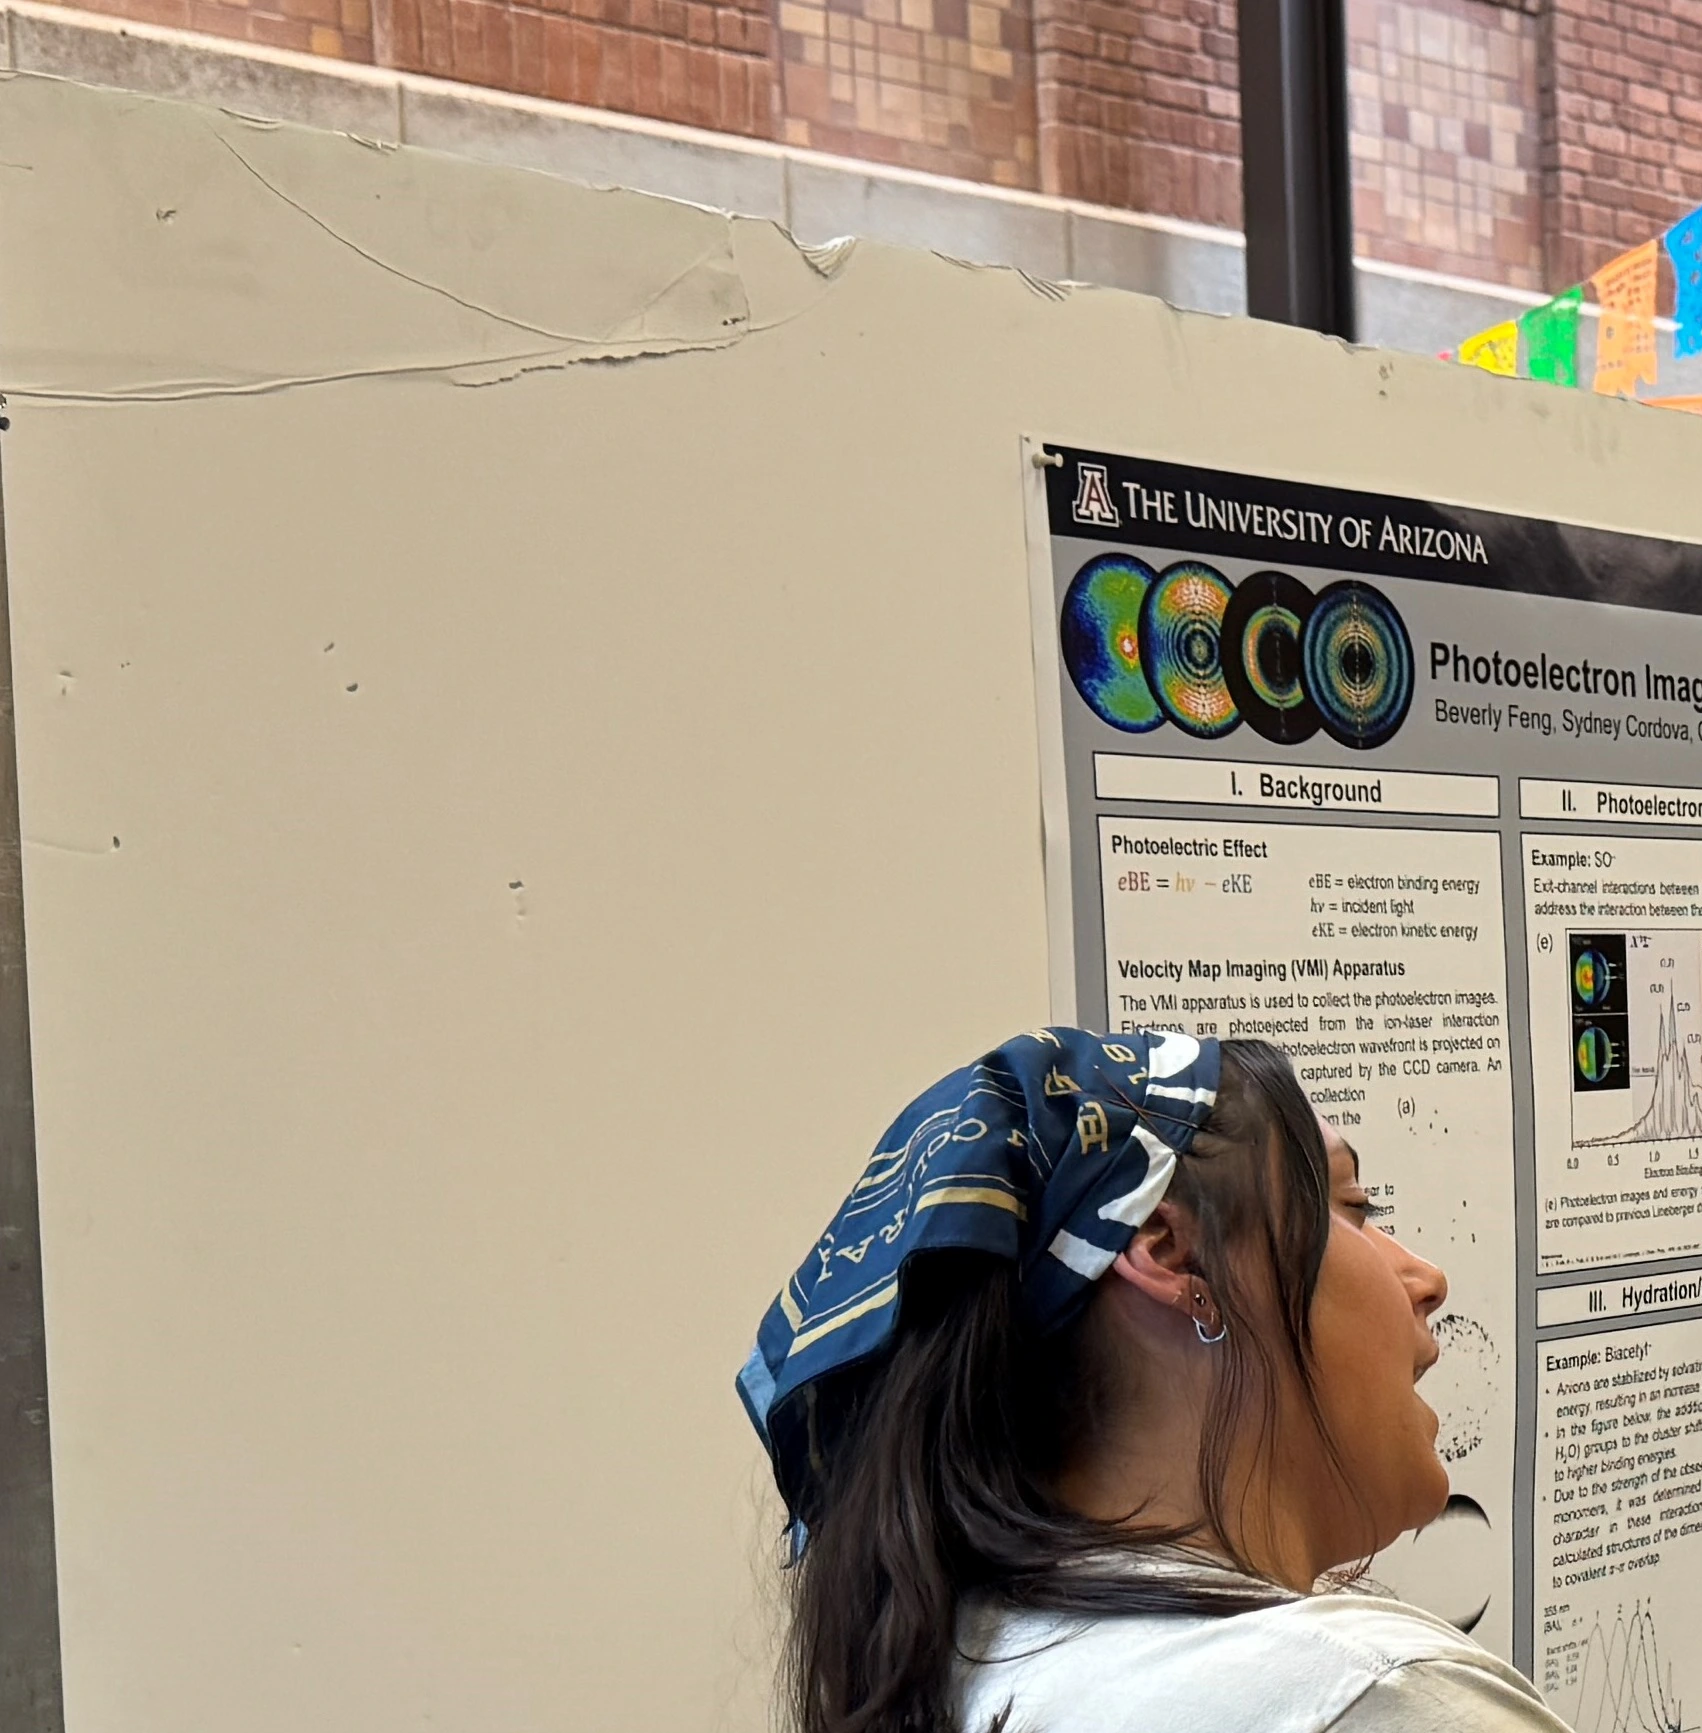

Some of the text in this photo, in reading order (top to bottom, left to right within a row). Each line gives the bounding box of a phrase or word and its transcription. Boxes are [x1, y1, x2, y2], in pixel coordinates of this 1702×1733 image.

[1122, 481, 1489, 564] THE UNIVERSITY OF ARIZONA
[1430, 642, 1636, 697] Photoelectron
[1435, 700, 1502, 731] Beverly
[1508, 706, 1557, 736] Feng,
[1562, 710, 1621, 740] Sydney
[1626, 716, 1693, 743] Cordova,
[1231, 771, 1382, 805] I. Background
[1562, 789, 1577, 812] II.
[1111, 835, 1268, 858] Photoelectric Effect
[1532, 850, 1591, 870] Example:
[1309, 874, 1332, 890] eBE
[1347, 874, 1394, 890] electron
[1398, 875, 1438, 893] binding
[1442, 878, 1480, 895] energy
[1536, 933, 1553, 953] (e)
[1118, 959, 1405, 982] Velocity Map Imaging (VMI) Apparatus
[1120, 995, 1146, 1011] The
[1150, 994, 1177, 1011] VMI
[1182, 994, 1246, 1013] apparatus
[1250, 993, 1260, 1008] is
[1264, 992, 1294, 1009] used
[1297, 993, 1308, 1008] to
[1312, 992, 1350, 1008] collect
[1354, 991, 1372, 1007] the
[1375, 991, 1451, 1010] photoelectron
[1196, 1021, 1217, 1035] are
[1229, 1016, 1308, 1036] photoejected
[1319, 1016, 1345, 1031] from
[1356, 1015, 1373, 1030] the
[1442, 1013, 1499, 1028] interaction
[1359, 1037, 1415, 1054] wavefront
[1418, 1038, 1428, 1052] is
[1432, 1036, 1483, 1056] projected
[1487, 1038, 1500, 1049] on
[1301, 1058, 1501, 1081] captured by the CCD camera. An
[1310, 1088, 1365, 1104] collection
[1397, 1097, 1416, 1117] (a)
[1589, 1290, 1606, 1312] III.
[1546, 1352, 1601, 1372] Example:
